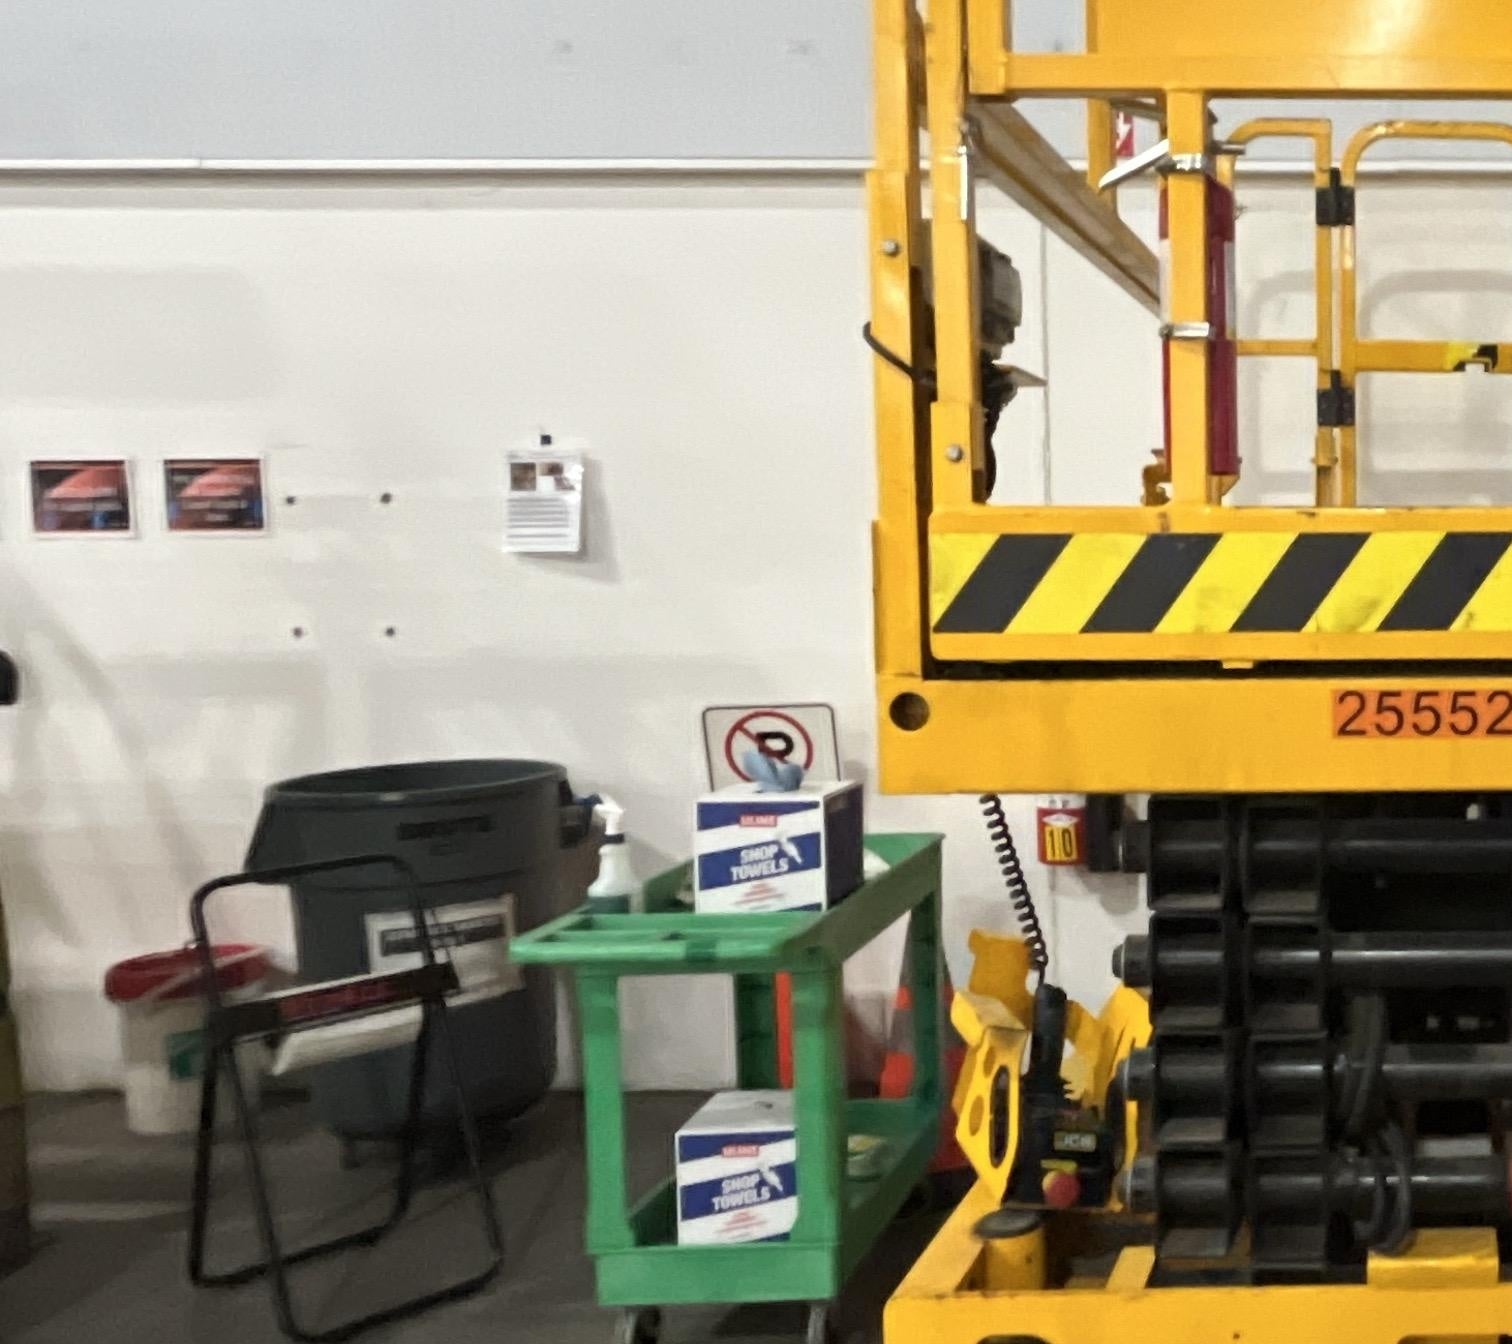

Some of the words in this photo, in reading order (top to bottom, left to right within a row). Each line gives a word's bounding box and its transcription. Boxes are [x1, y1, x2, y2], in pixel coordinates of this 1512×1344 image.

[741, 844, 779, 866] SHOP
[1048, 828, 1074, 858] 10
[730, 857, 789, 881] TOWELS
[721, 1172, 761, 1195] SHOP
[712, 1185, 770, 1212] TOWELS
